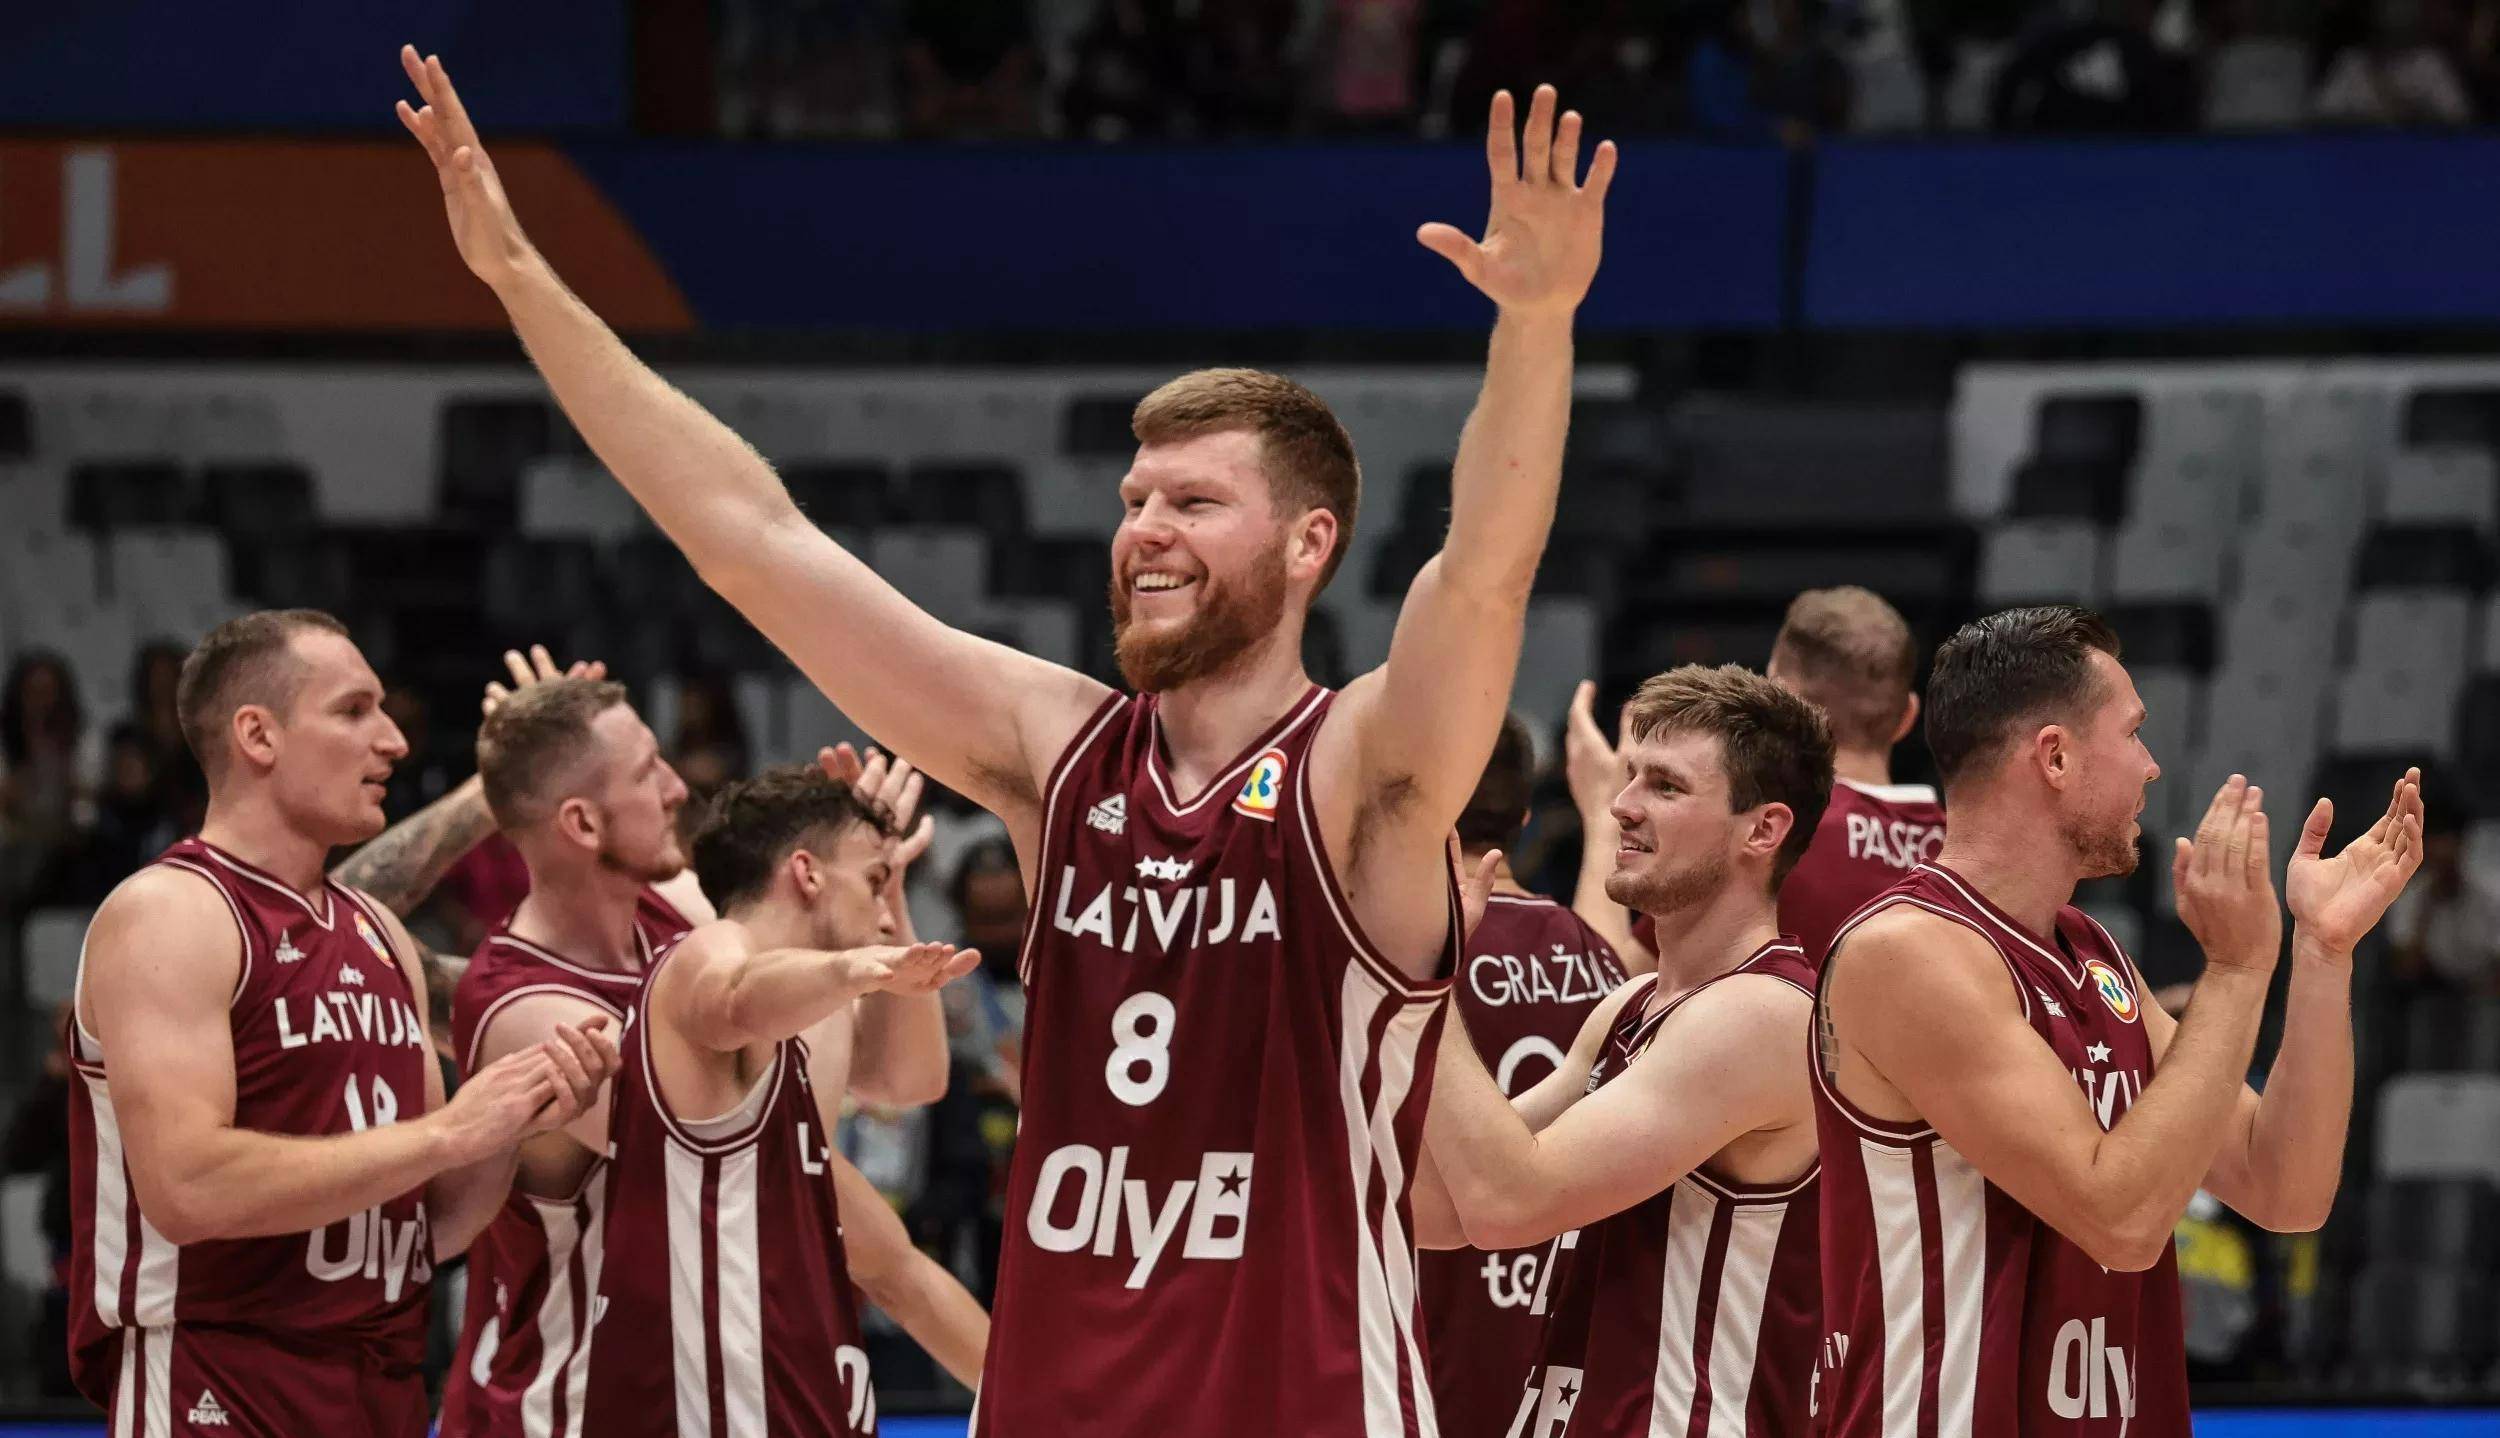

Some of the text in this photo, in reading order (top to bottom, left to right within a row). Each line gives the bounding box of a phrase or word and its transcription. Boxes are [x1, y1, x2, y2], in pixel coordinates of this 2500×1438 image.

[1086, 805, 1128, 835] PEAK
[1054, 864, 1283, 953] LATVIJA
[1469, 944, 1626, 1007] GRAŽU
[274, 991, 424, 1049] LATVIJA
[1105, 991, 1177, 1106] 8
[1027, 1143, 1254, 1289] OlyB
[1480, 1252, 1538, 1309] te
[2047, 1316, 2137, 1438] Oly
[187, 1407, 230, 1426] PEAK
